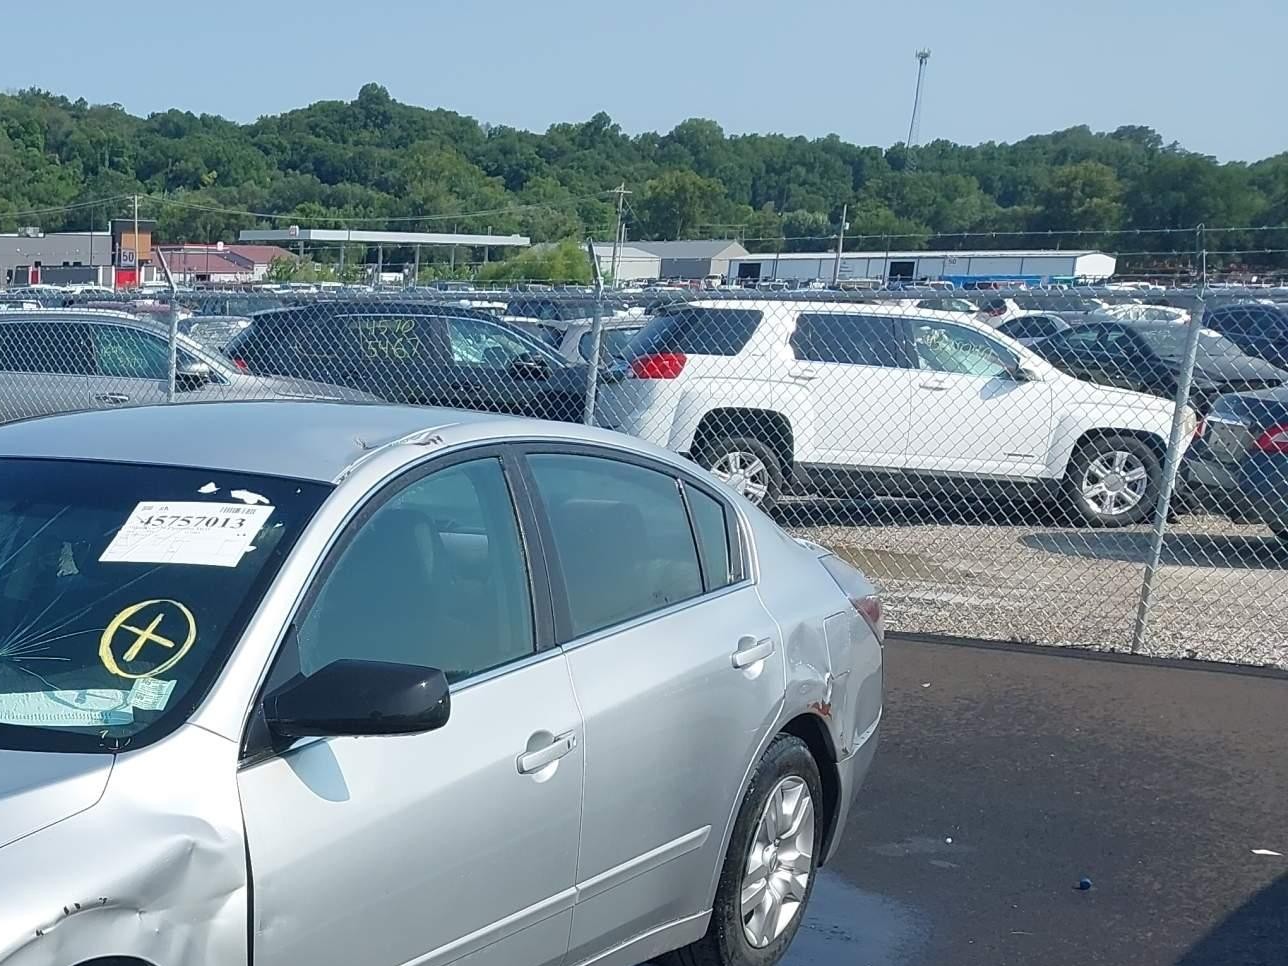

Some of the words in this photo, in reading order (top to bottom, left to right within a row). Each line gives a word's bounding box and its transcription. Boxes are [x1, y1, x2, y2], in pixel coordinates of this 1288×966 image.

[122, 251, 135, 262] 50
[367, 336, 420, 359] 5467
[140, 514, 247, 530] 45757013
